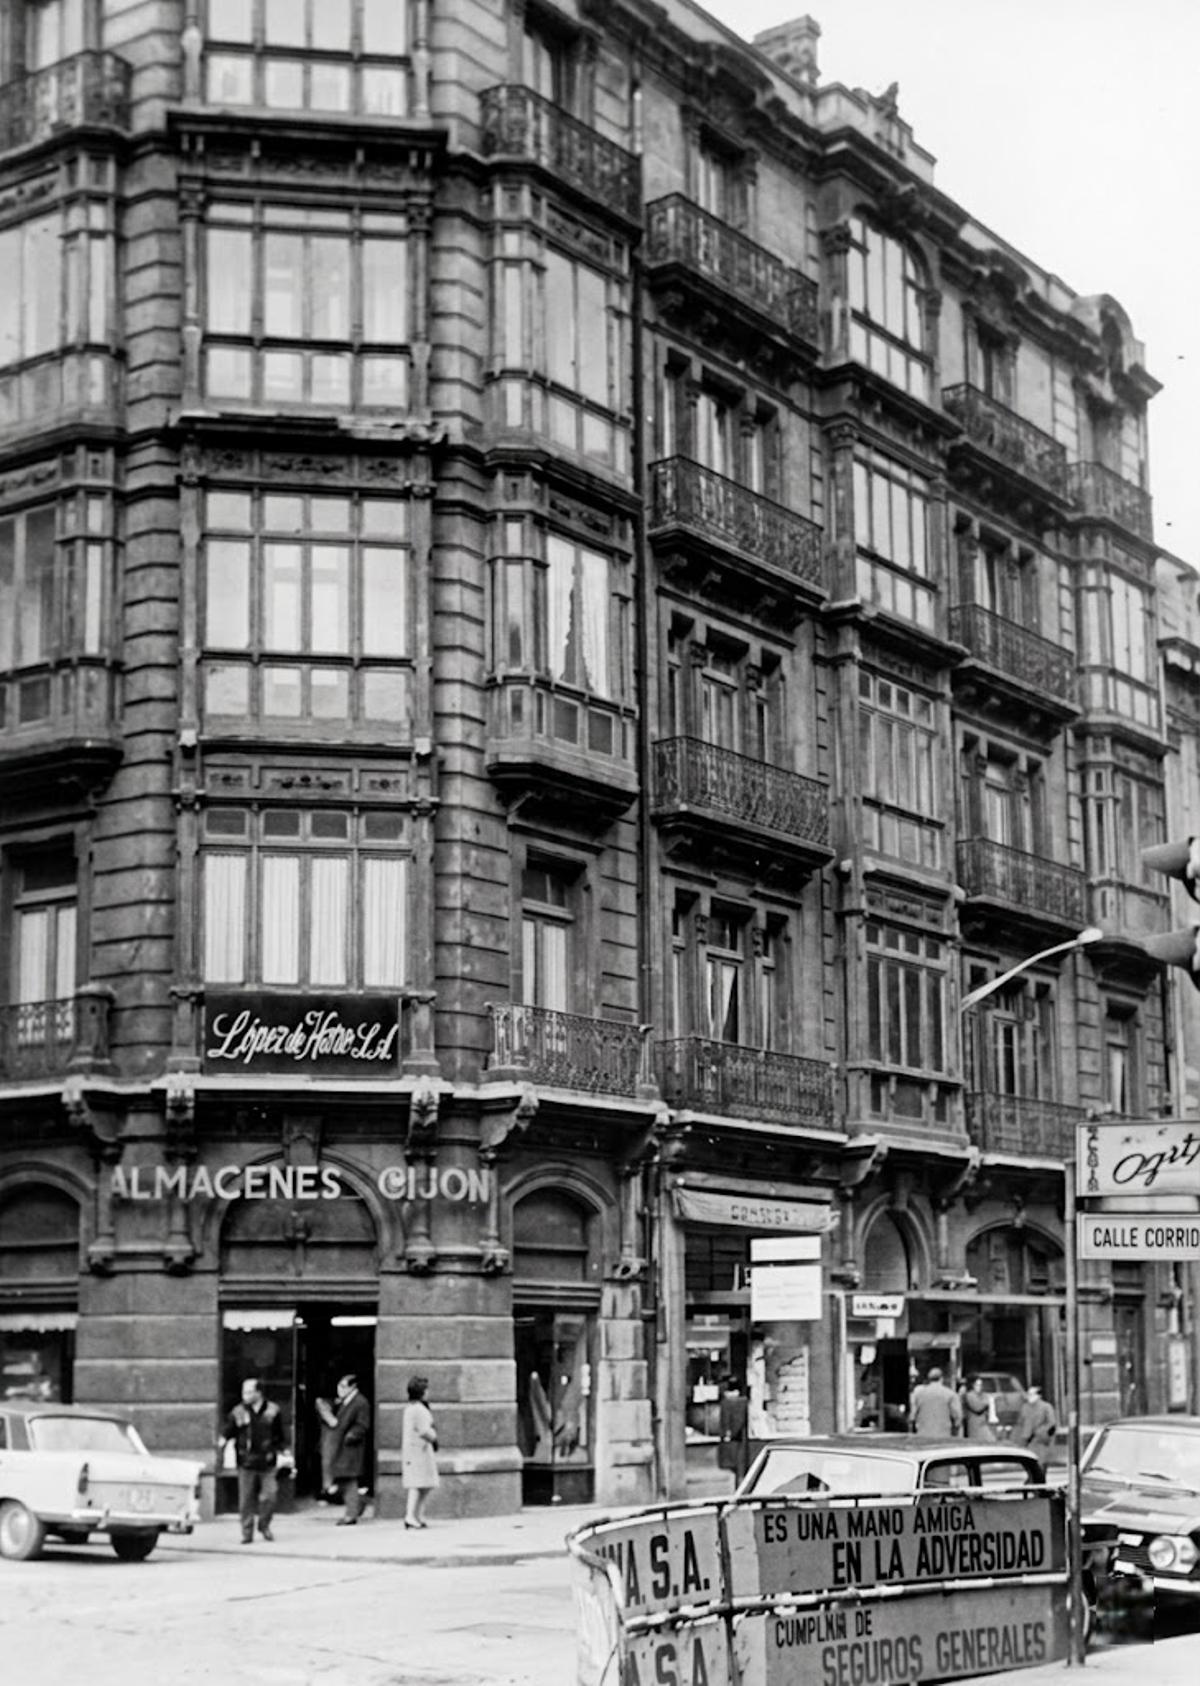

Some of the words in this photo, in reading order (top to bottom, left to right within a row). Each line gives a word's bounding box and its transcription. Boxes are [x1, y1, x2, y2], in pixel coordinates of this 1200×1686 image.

[284, 1022, 307, 1054] de
[111, 1165, 342, 1200] ALMACENES
[1093, 1227, 1139, 1248] CALLE
[764, 1514, 788, 1544] ES
[797, 1512, 839, 1541] UNA
[847, 1508, 904, 1538] MANO
[913, 1504, 976, 1535] AMIGA
[832, 1541, 862, 1586] EN
[875, 1538, 905, 1581] LA
[916, 1529, 1044, 1577] ADVERSIDAD
[855, 1609, 873, 1638] DE
[822, 1634, 924, 1686] SEGUROS
[935, 1622, 1046, 1674] GENERALES
